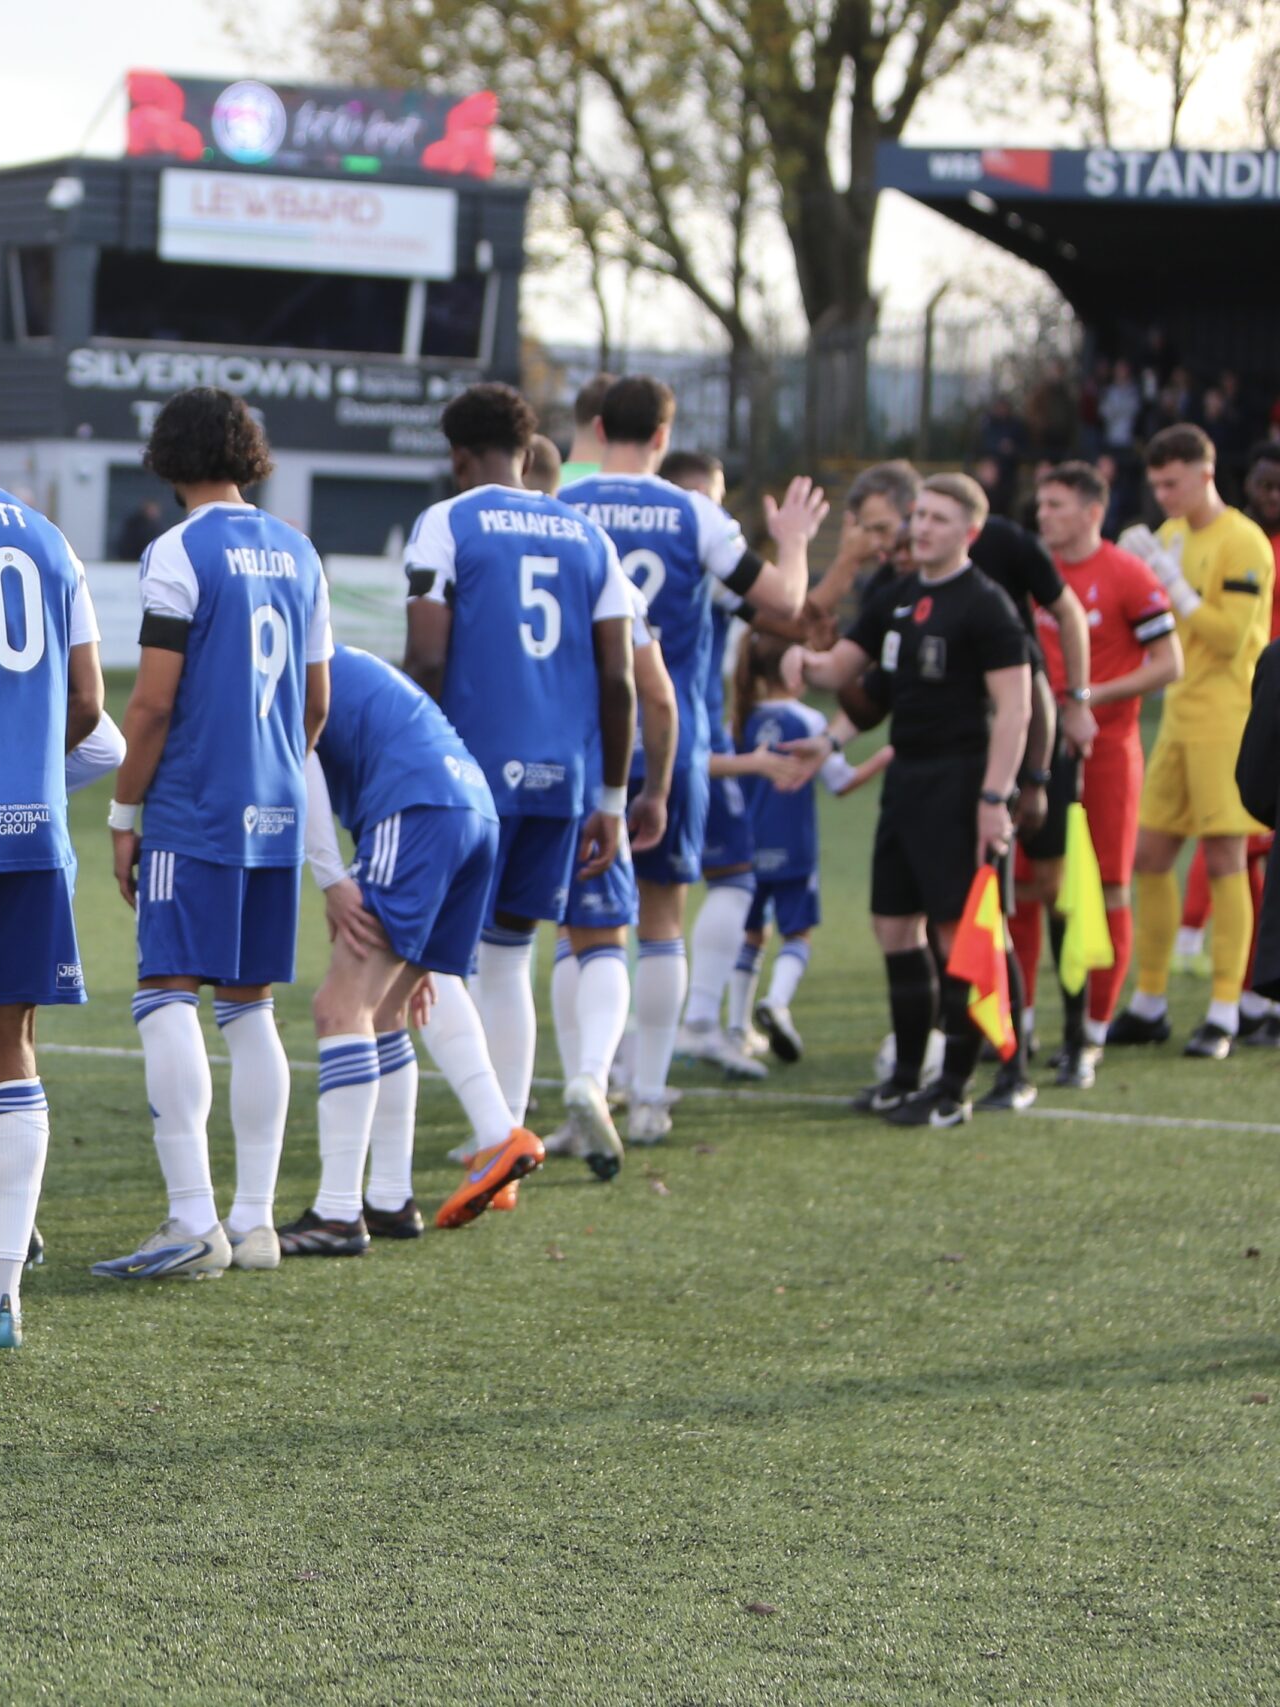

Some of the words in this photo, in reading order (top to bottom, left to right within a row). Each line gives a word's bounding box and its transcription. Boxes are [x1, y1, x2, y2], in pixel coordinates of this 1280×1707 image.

[1084, 149, 1280, 198] STANDI
[67, 349, 333, 399] SILVERTOWN
[478, 509, 590, 544] MENAYESE
[568, 503, 682, 534] EATHCOTE
[225, 548, 298, 578] MELLOR
[519, 555, 562, 661] 5
[251, 604, 289, 719] 9
[8, 803, 50, 811] INTERNATIONAL
[0, 823, 38, 836] GROUP
[59, 965, 83, 977] JBS
